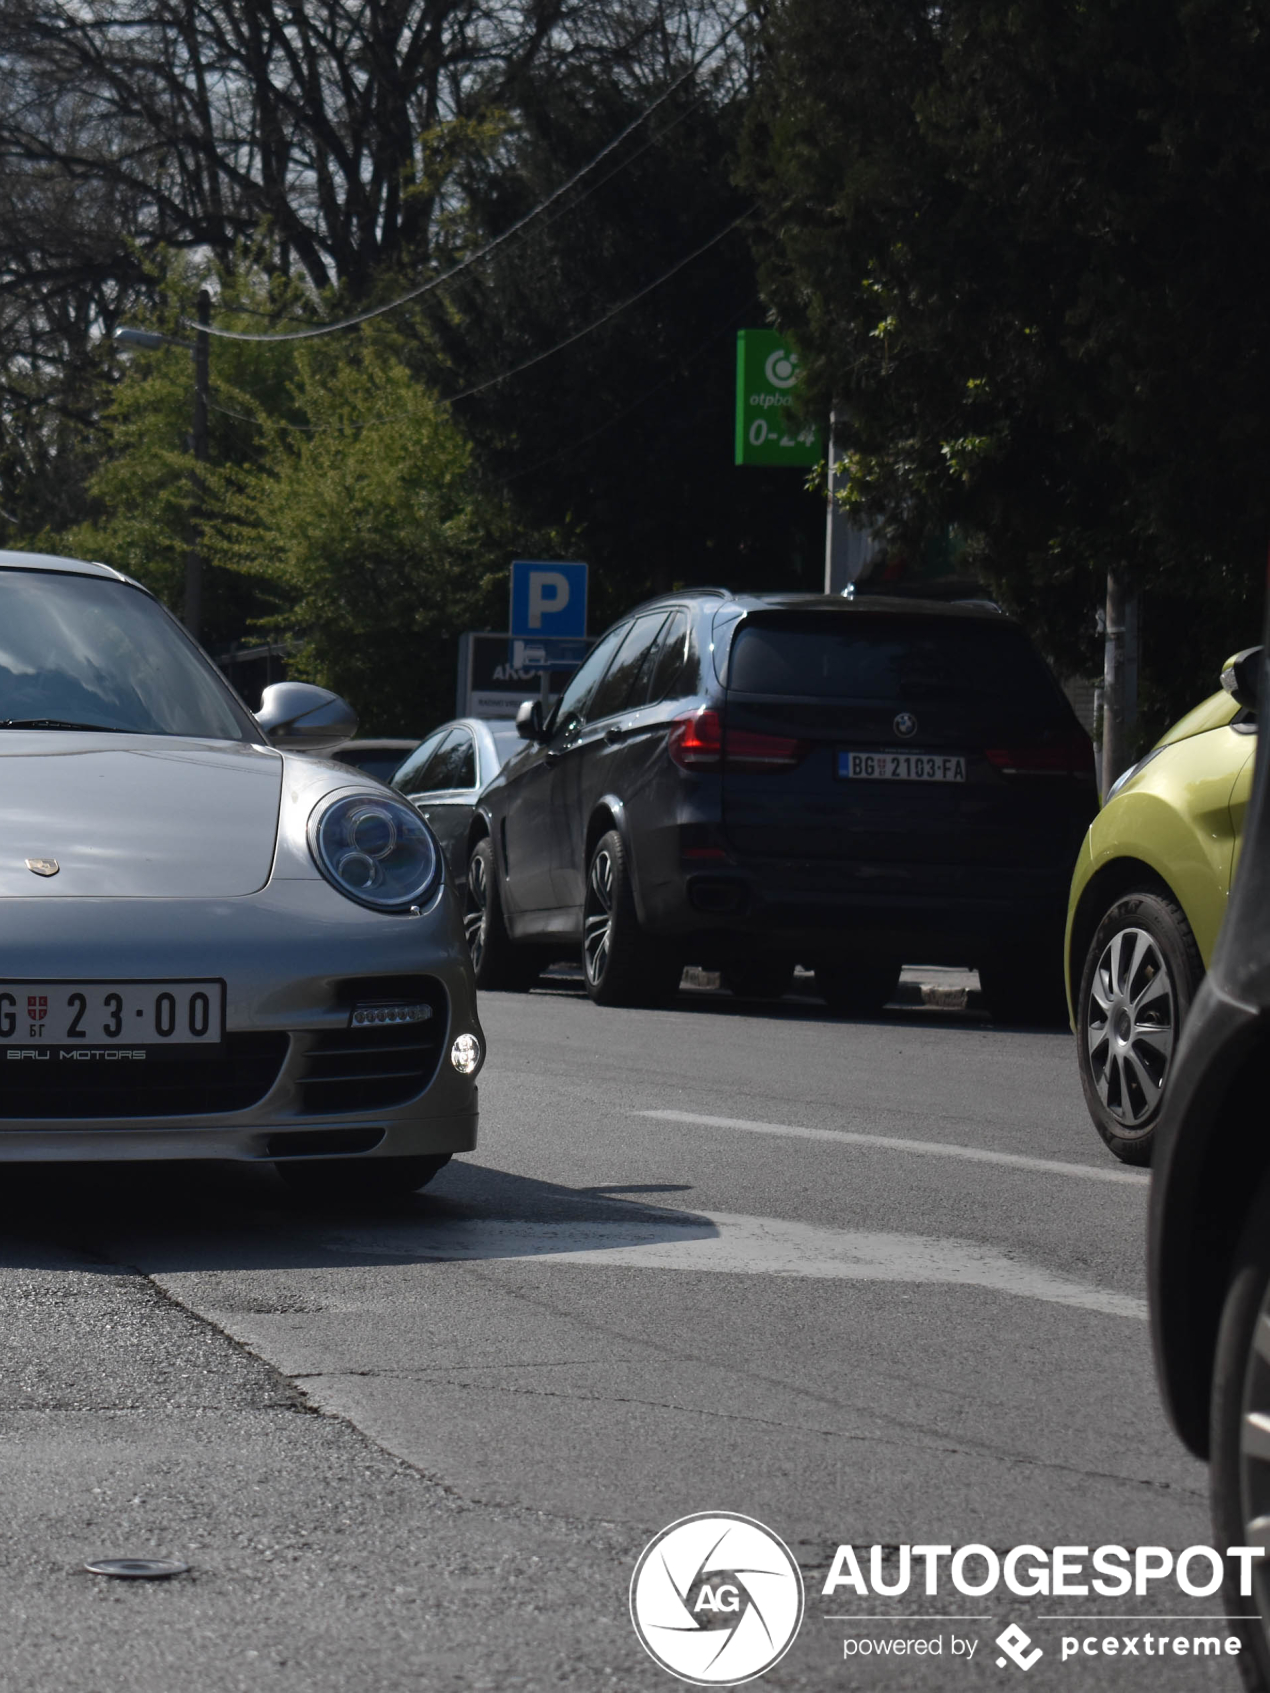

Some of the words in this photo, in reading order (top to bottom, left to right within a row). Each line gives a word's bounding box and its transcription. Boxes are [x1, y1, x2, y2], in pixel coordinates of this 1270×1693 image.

[749, 392, 793, 409] otpba
[528, 572, 570, 629] P
[852, 755, 875, 776] BG
[6, 1050, 50, 1060] BRU
[59, 1050, 147, 1060] MOTORS
